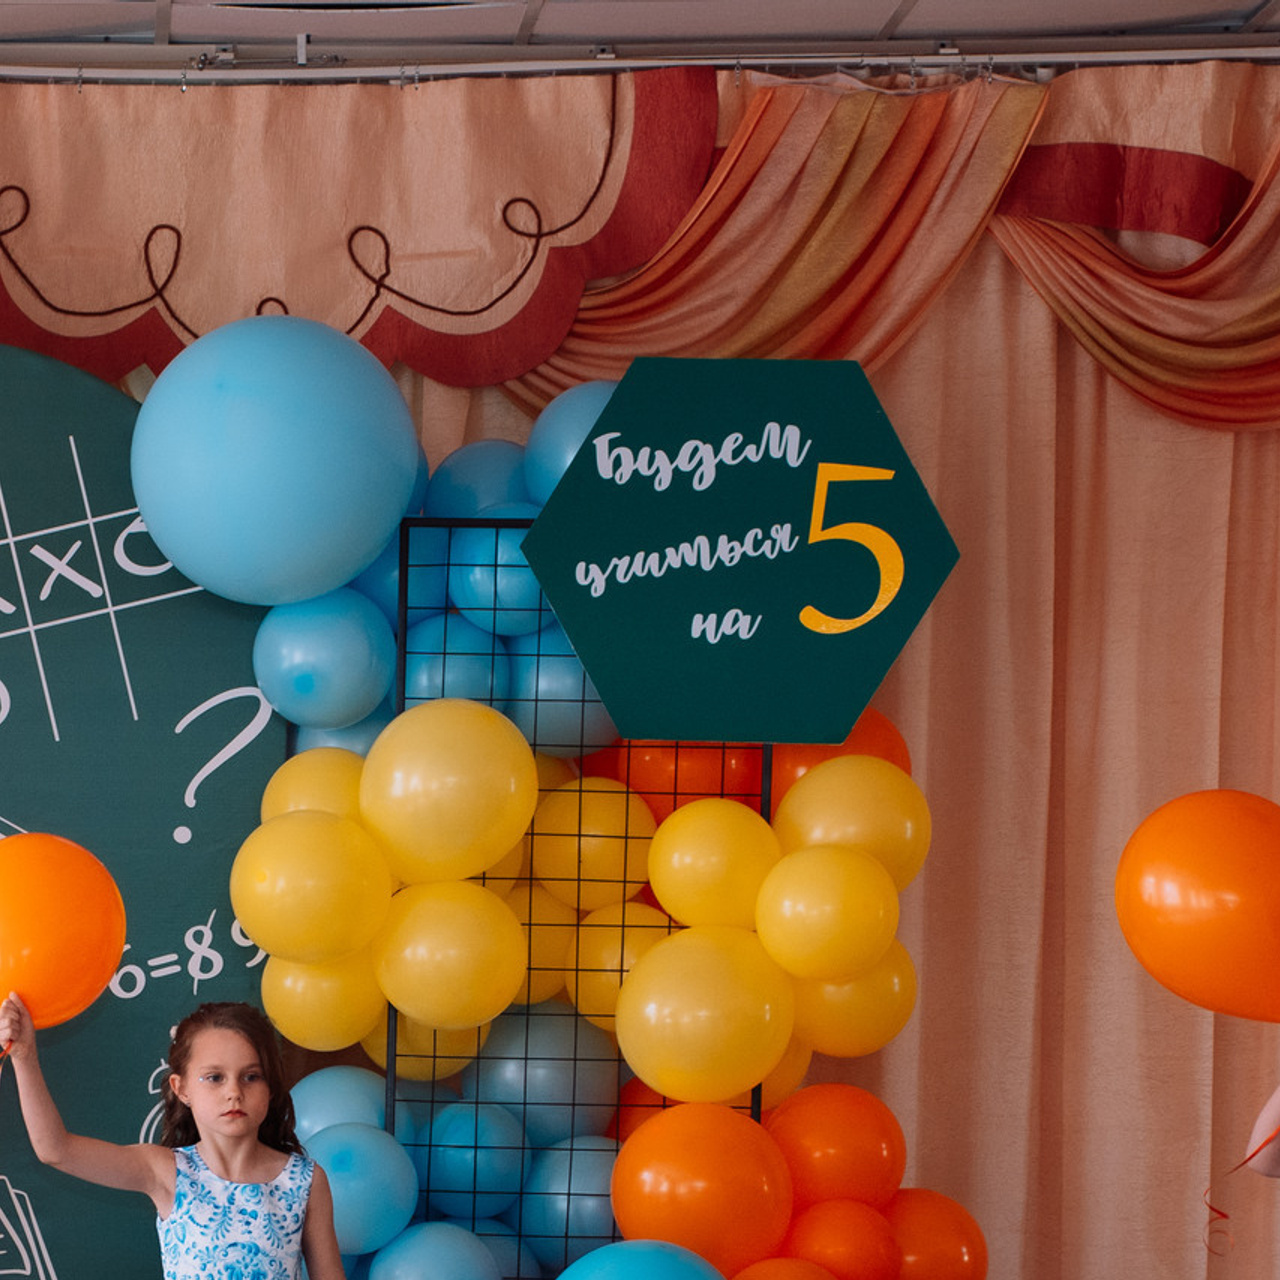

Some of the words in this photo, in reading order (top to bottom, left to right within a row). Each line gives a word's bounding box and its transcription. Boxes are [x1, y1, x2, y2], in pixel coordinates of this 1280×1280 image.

[592, 421, 812, 491] Будем
[575, 522, 800, 598] учиться
[690, 608, 763, 645] на
[798, 462, 905, 635] 5
